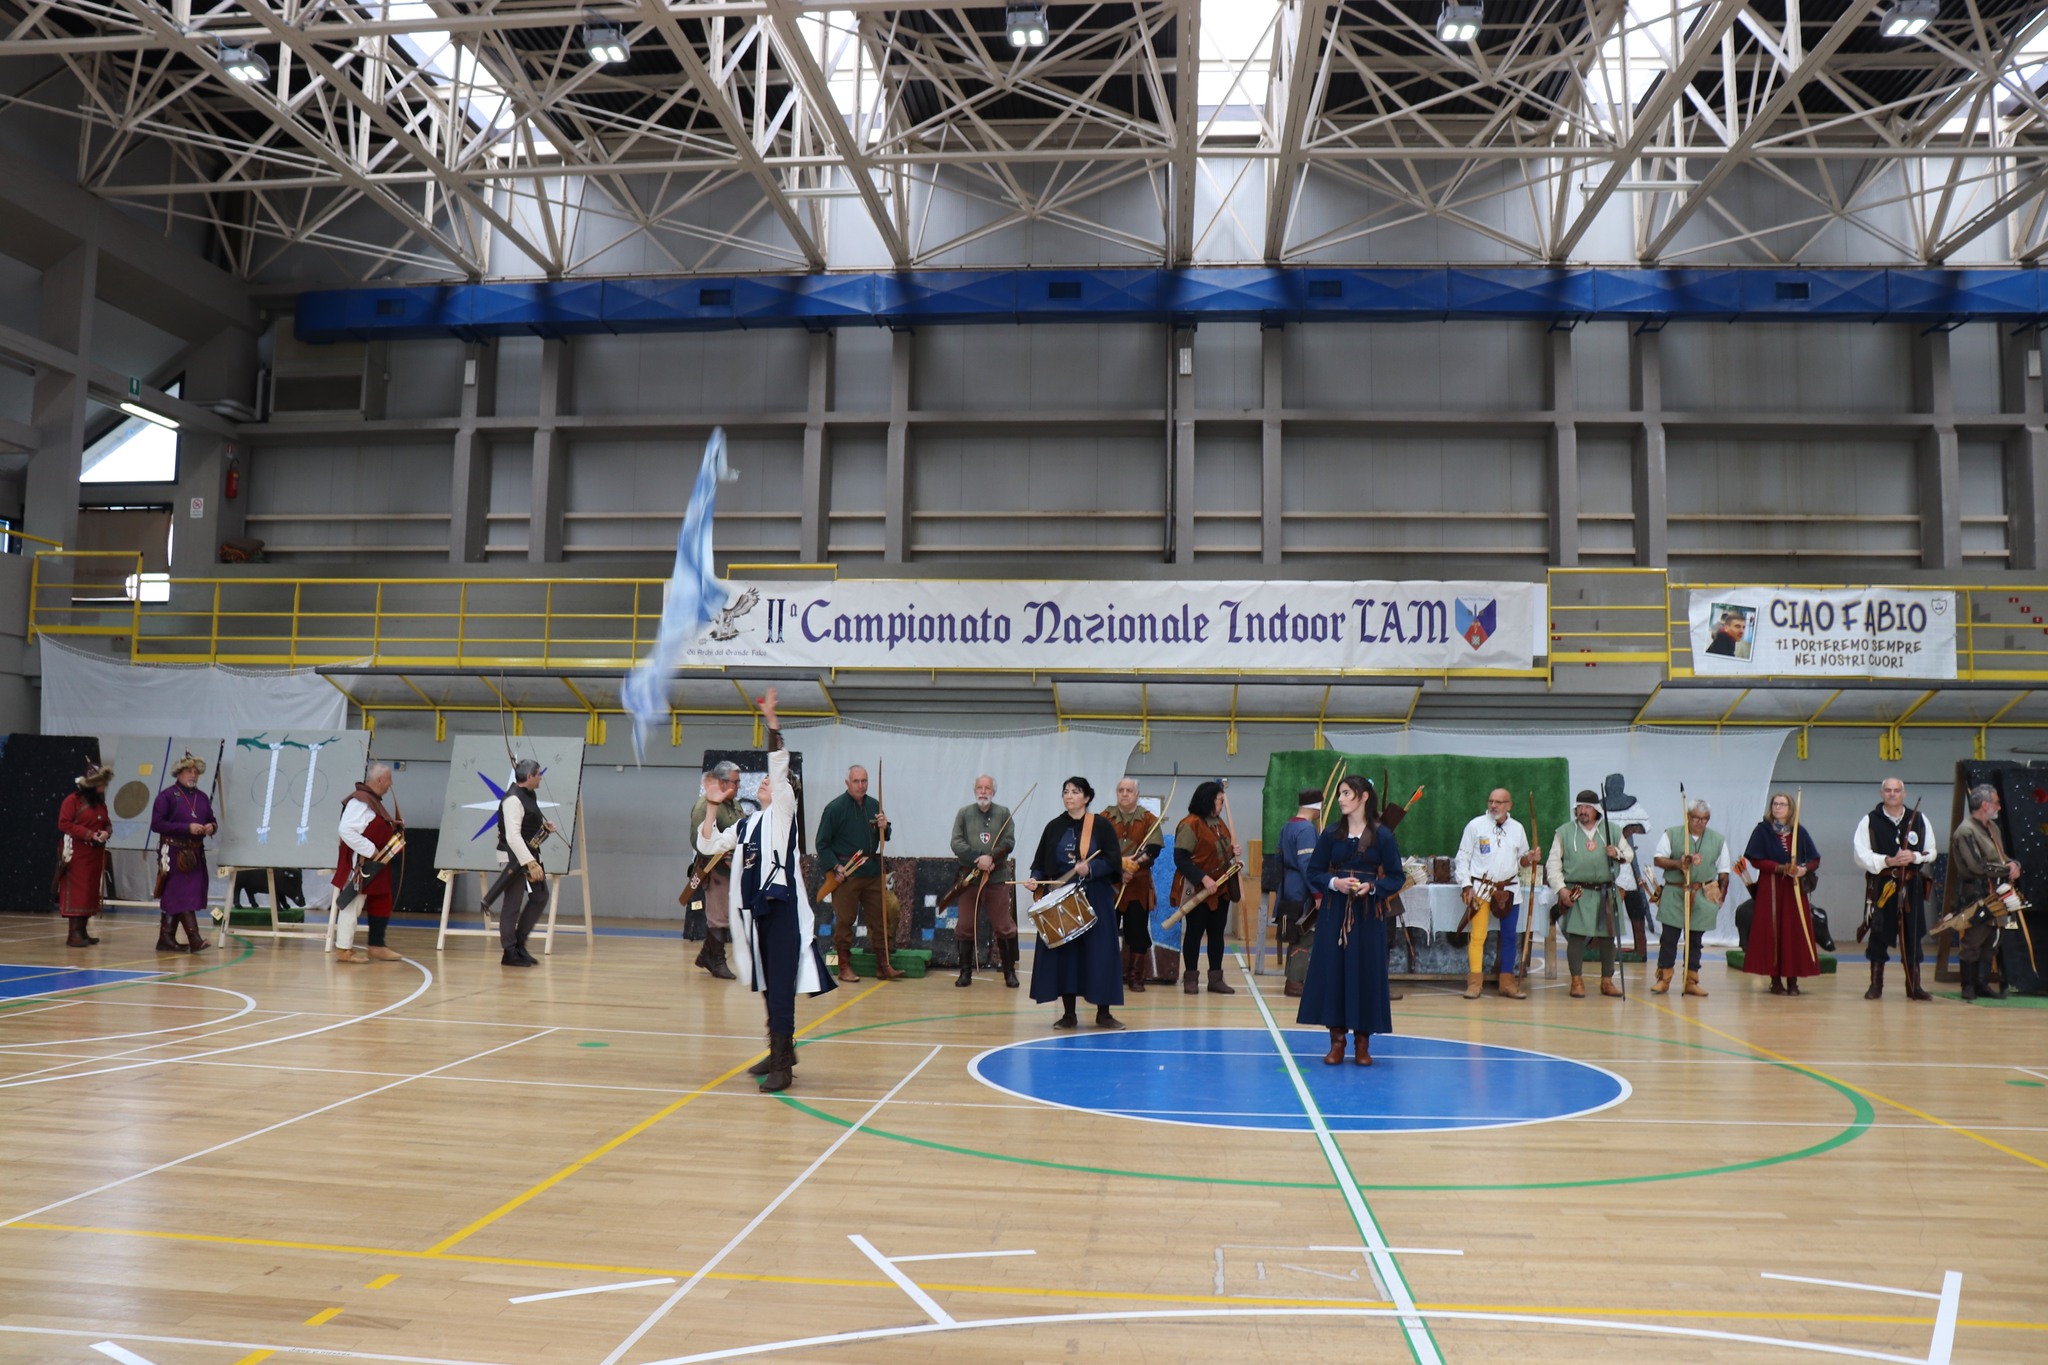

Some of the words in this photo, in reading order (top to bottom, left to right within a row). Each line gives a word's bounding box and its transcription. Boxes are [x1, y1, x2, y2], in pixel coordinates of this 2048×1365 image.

[801, 599, 1010, 651] Campionato
[1022, 600, 1210, 644] Nazionale
[1219, 600, 1346, 643] Indoor
[1352, 598, 1449, 644] LAM
[1770, 599, 1835, 636] CIAO
[1842, 599, 1927, 636] FABIO
[1792, 638, 1869, 651] PORTEREMO
[1872, 640, 1922, 654] SEMPRE
[1795, 653, 1816, 667] NEI
[1821, 653, 1865, 666] NOSTRI
[1868, 655, 1904, 668] CUORI
